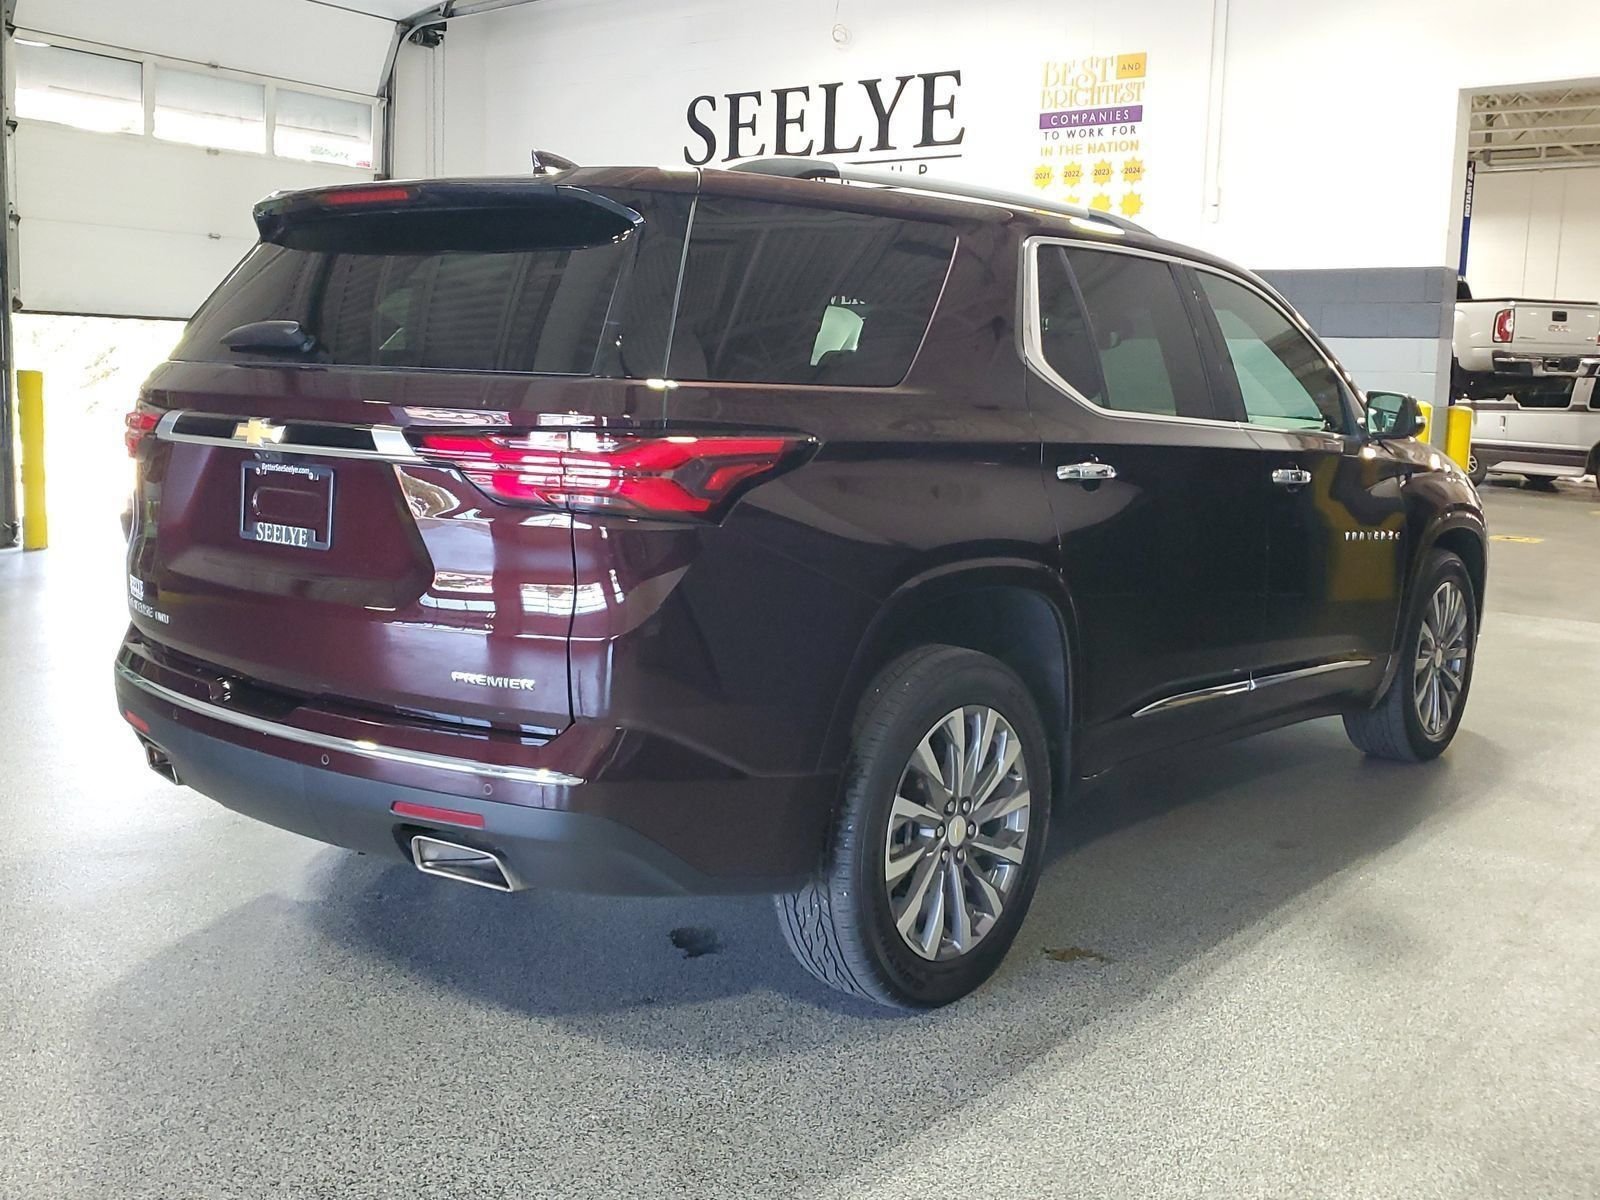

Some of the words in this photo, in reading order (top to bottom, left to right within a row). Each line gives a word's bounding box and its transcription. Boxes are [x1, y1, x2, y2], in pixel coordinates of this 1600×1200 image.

[1041, 56, 1114, 89] BEST
[1122, 62, 1141, 72] AND
[684, 70, 965, 166] SEELYE
[1050, 109, 1130, 126] COMPANIES
[1043, 131, 1060, 141] TO
[1066, 127, 1104, 139] WORK
[1111, 125, 1137, 136] FOR
[1040, 146, 1053, 157] IN
[1058, 144, 1083, 156] THE
[1087, 139, 1140, 155] NATION
[1035, 172, 1050, 180] 2021
[1064, 170, 1080, 178] 2022
[1094, 168, 1110, 176] 2023
[1124, 167, 1141, 175] 2024
[1464, 180, 1473, 218] ROTARY
[256, 522, 308, 548] SEELYE
[451, 671, 536, 691] PREMIER
